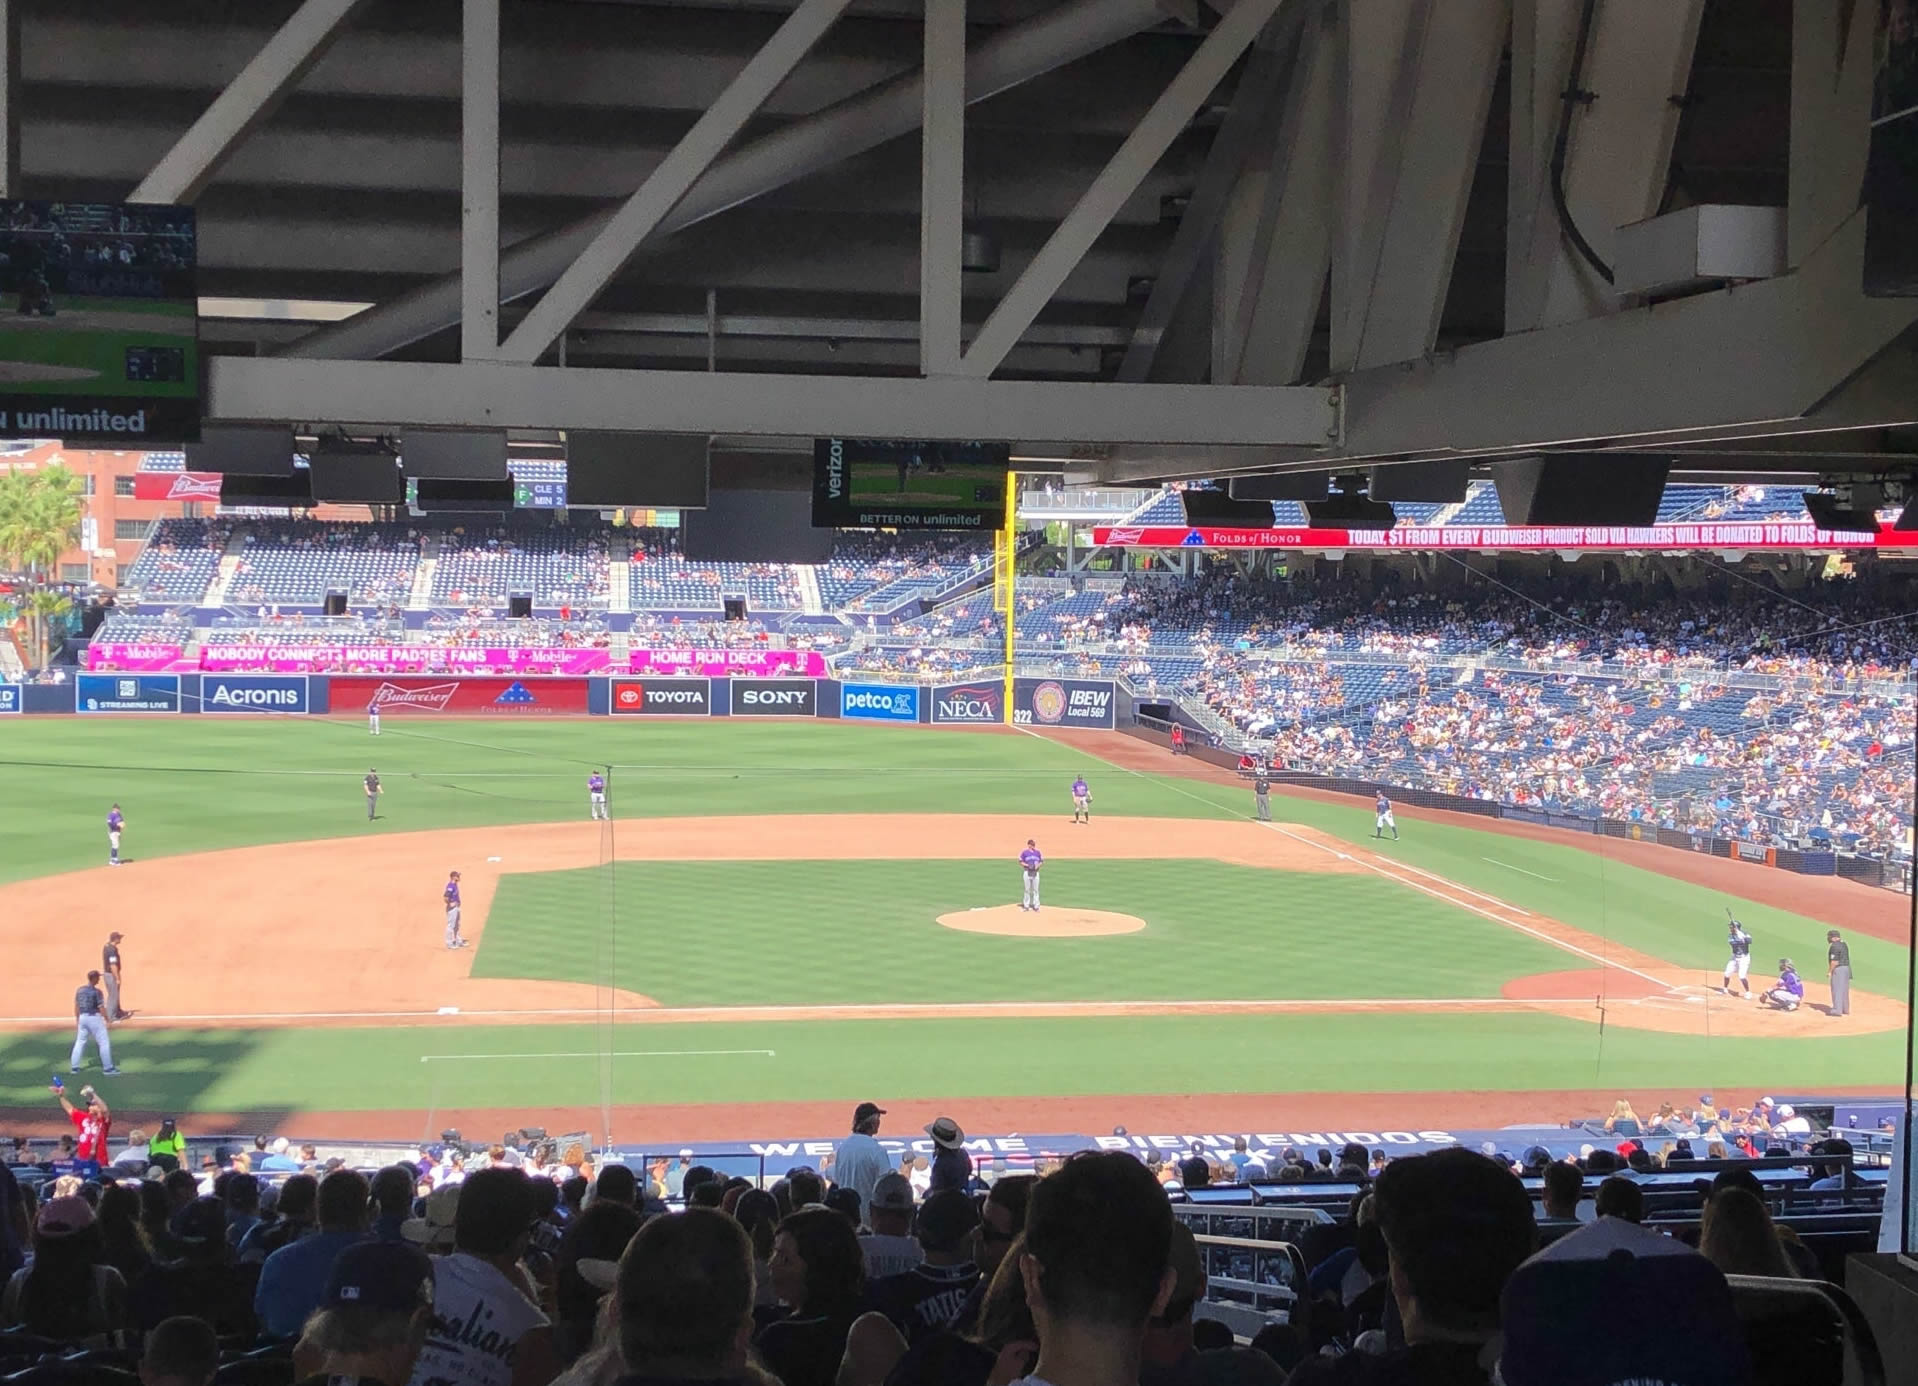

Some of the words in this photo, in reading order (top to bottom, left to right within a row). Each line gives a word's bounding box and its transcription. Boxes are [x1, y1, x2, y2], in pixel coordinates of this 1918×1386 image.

[16, 408, 145, 432] unlimited
[519, 491, 526, 499] F
[535, 485, 553, 493] CLE
[556, 485, 563, 494] 5
[535, 496, 552, 505] MIN
[556, 497, 563, 505] 2
[860, 514, 901, 524] BETTER
[903, 515, 920, 524] ON
[923, 514, 982, 525] unlimited
[1213, 533, 1247, 543] FOLDS
[1249, 533, 1257, 545] of
[1261, 532, 1301, 543] HONOR
[1348, 530, 1388, 545] TODAY,
[1389, 529, 1403, 545] $1
[1406, 529, 1440, 544] FROM
[1443, 529, 1480, 544] EVERY
[1483, 528, 1542, 544] BUDWEISER
[1543, 528, 1584, 544] PRODUCT
[1585, 528, 1609, 544] SOLD
[1610, 528, 1626, 544] VIA
[1627, 527, 1674, 544] HAWKERS
[1676, 527, 1700, 544] WILL
[1701, 527, 1714, 543] BE
[1717, 526, 1763, 543] DONATED
[1765, 526, 1779, 543] TO
[1781, 525, 1815, 543] FOLDS
[207, 648, 265, 660] NOBODY
[346, 648, 388, 661] MORE
[451, 649, 487, 662] FANS
[650, 652, 691, 664] HOME
[695, 652, 726, 664] RUN
[728, 652, 767, 664] DECK
[212, 685, 298, 704] Acronis
[377, 687, 450, 703] Budweiser
[646, 692, 704, 703] TOYOTA
[743, 691, 808, 704] SONY
[1070, 690, 1111, 706] IBEW
[846, 692, 892, 711] petco
[938, 701, 994, 718] NECA
[1068, 706, 1089, 717] Local
[1090, 707, 1106, 718] 569
[1014, 710, 1033, 723] 322
[1094, 1131, 1457, 1149] BIENVENIDOS
